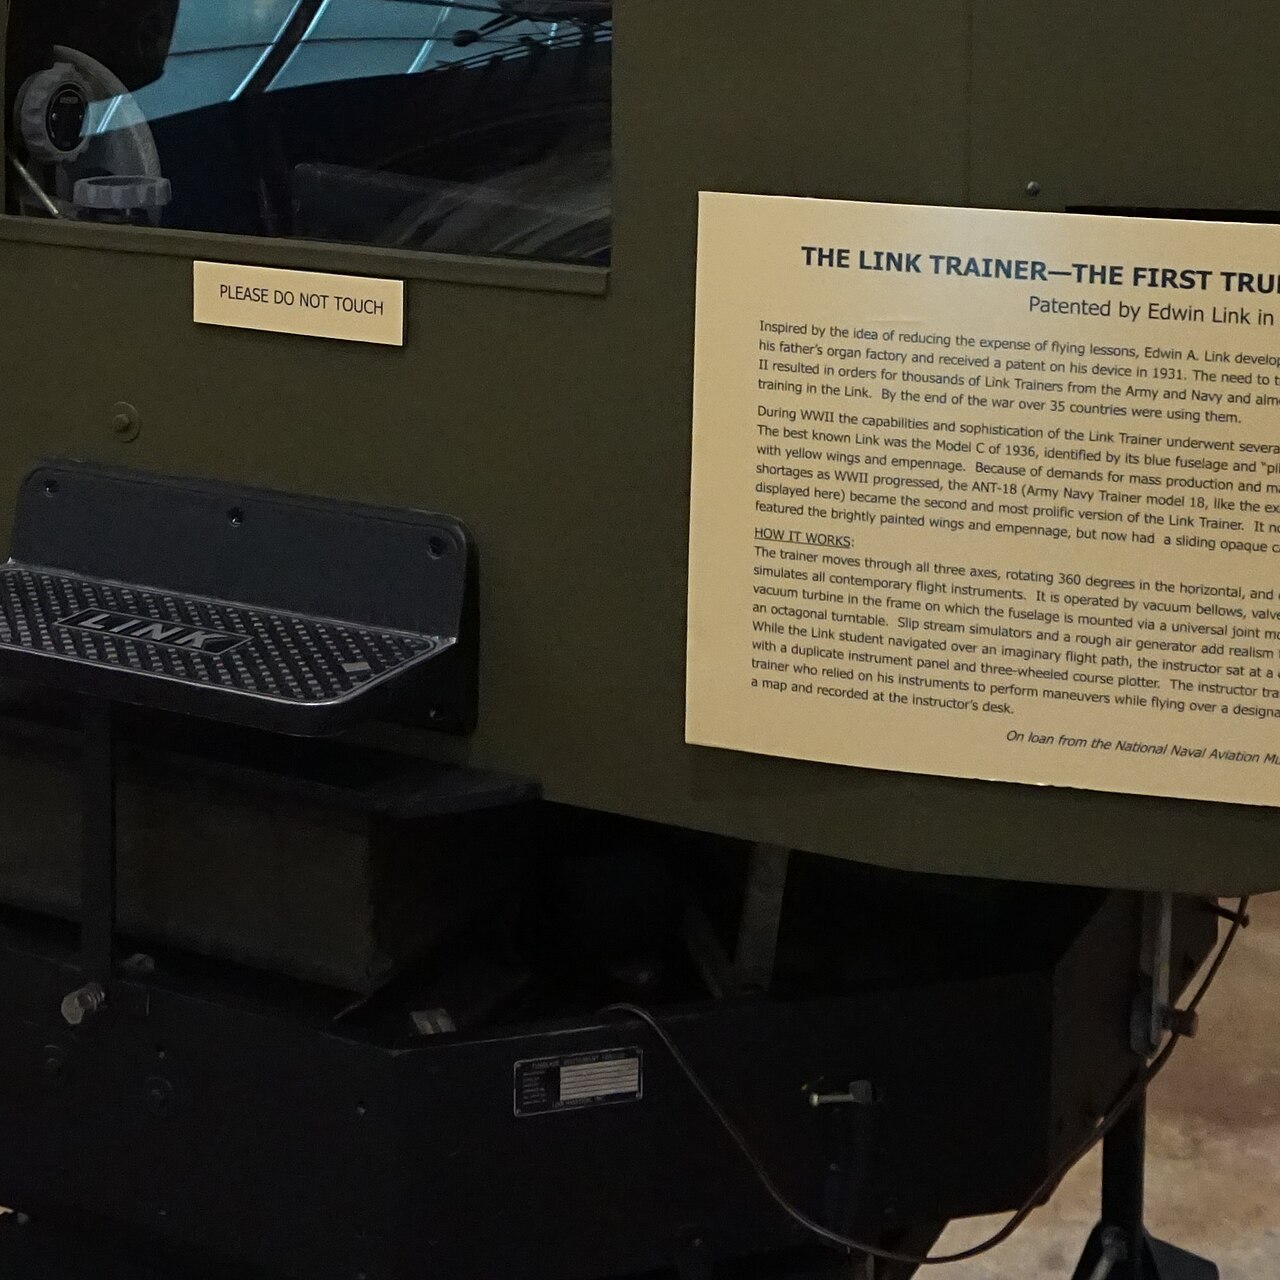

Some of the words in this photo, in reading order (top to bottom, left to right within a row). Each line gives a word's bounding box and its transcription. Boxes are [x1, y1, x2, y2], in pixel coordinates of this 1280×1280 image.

[801, 246, 850, 269] THE
[859, 250, 922, 273] LINK
[1133, 266, 1213, 290] FIRST
[220, 284, 269, 303] PLEASE
[274, 289, 294, 306] DO
[300, 293, 329, 309] NOT
[335, 295, 384, 316] TOUCH
[1029, 295, 1111, 317] Patented
[1119, 300, 1141, 321] by
[1148, 302, 1204, 322] Edwin
[1211, 306, 1251, 325] Link
[1258, 309, 1274, 326] in
[760, 320, 808, 335] Inspired
[811, 324, 826, 338] by
[829, 326, 849, 338] the
[853, 327, 878, 340] idea
[882, 329, 895, 341] of
[899, 332, 951, 348] reducing
[955, 334, 975, 347] the
[979, 338, 1031, 351] expense
[1034, 340, 1048, 352] of
[1051, 340, 1085, 357] flying
[1089, 343, 1139, 360] lessons,
[1144, 346, 1182, 360] Edwin
[1186, 349, 1199, 361] A.
[1204, 350, 1230, 363] Link
[759, 338, 776, 352] his
[826, 347, 862, 360] organ
[865, 348, 908, 365] factory
[911, 352, 934, 364] and
[938, 355, 990, 368] received
[994, 359, 1001, 369] a
[1005, 359, 1046, 372] patent
[1049, 363, 1065, 373] on
[1070, 361, 1088, 374] his
[1091, 363, 1132, 377] device
[1136, 366, 1148, 378] in
[1153, 367, 1187, 381] 1931.
[1192, 369, 1217, 382] The
[1221, 373, 1253, 385] need
[1257, 374, 1270, 386] to
[759, 358, 768, 370] II
[772, 362, 820, 375] resulted
[824, 364, 835, 376] in
[838, 366, 877, 380] orders
[881, 368, 898, 381] for
[901, 370, 965, 386] thousands
[968, 375, 981, 387] of
[985, 376, 1010, 389] Link
[1014, 378, 1063, 392] Trainers
[1067, 381, 1096, 394] from
[1101, 383, 1122, 396] the
[1125, 385, 1159, 401] Army
[1163, 389, 1187, 400] and
[1191, 389, 1223, 405] Navy
[1227, 392, 1251, 405] and
[754, 527, 785, 542] HOW
[789, 530, 802, 545] IT
[805, 532, 855, 550] WORKS:
[753, 585, 798, 598] vacuum
[802, 589, 844, 603] turbine
[848, 593, 858, 605] in
[862, 594, 882, 607] the
[886, 596, 921, 610] frame
[925, 602, 940, 612] on
[944, 602, 980, 615] which
[984, 605, 1004, 618] the
[1008, 607, 1060, 625] fuselage
[1064, 612, 1074, 624] is
[1078, 615, 1133, 629] mounted
[1137, 618, 1155, 630] via
[1159, 622, 1167, 631] a
[1171, 622, 1228, 636] universal
[1231, 626, 1260, 639] joint
[78, 613, 229, 649] LINK
[751, 678, 758, 687] a
[762, 679, 787, 693] map
[791, 682, 813, 694] and
[817, 686, 869, 701] recorded
[872, 691, 885, 702] at
[889, 692, 908, 704] the
[982, 701, 1014, 714] desk.
[1006, 730, 1025, 742] On
[1027, 731, 1055, 744] loan
[1058, 734, 1088, 747] from
[1090, 738, 1112, 750] the
[1115, 740, 1169, 755] National
[1170, 745, 1207, 758] Naval
[1208, 748, 1260, 763] Aviation
